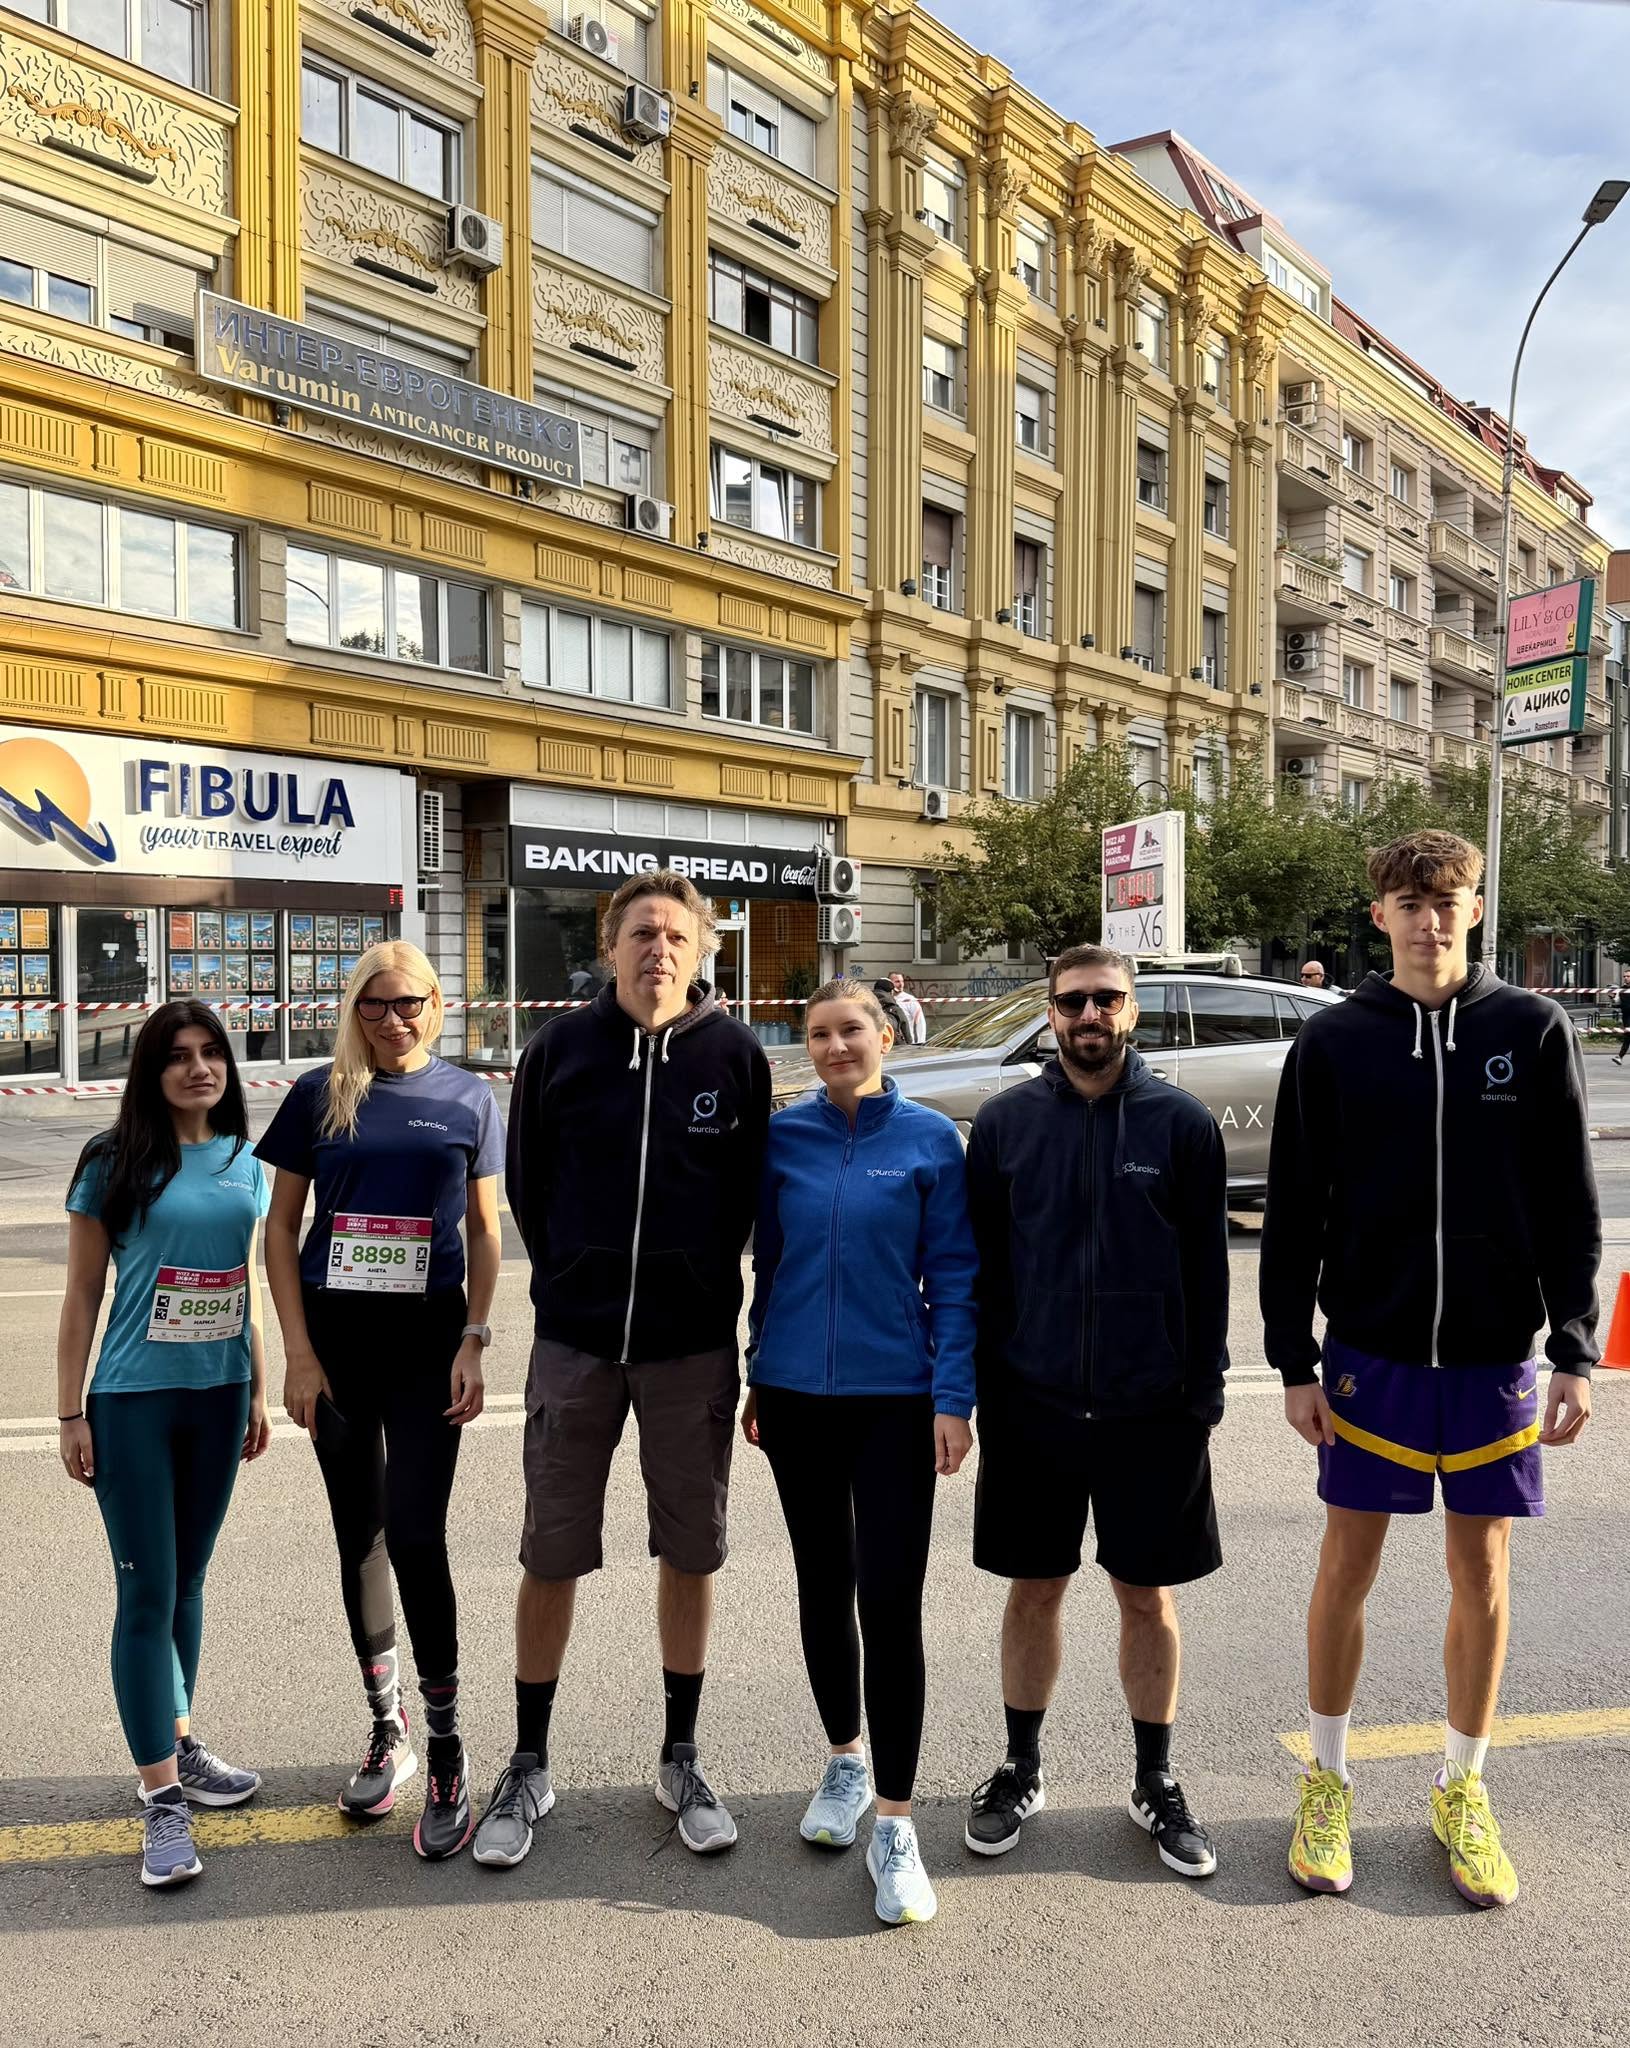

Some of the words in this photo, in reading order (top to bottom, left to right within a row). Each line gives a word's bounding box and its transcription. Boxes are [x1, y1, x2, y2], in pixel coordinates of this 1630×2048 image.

[213, 305, 574, 452] ИНТЕР-ЕВРОГЕНЕКС
[215, 344, 361, 413] Varumin
[369, 402, 490, 454] ANTICANCER
[495, 441, 574, 480] PRODUCT
[1514, 612, 1542, 632] LILY
[1544, 610, 1553, 624] &
[1556, 604, 1574, 621] CO
[1507, 675, 1534, 691] HOME
[1536, 665, 1571, 684] CENTER
[1524, 688, 1571, 713] АЏИКО
[138, 758, 355, 828] FIBULA
[143, 824, 202, 852] your
[206, 830, 276, 850] TRAVEL
[280, 831, 343, 860] expert
[525, 844, 658, 875] BAKING
[669, 855, 768, 883] BREAD
[1138, 910, 1163, 949] X6
[687, 1126, 720, 1134] sourcico
[1207, 1104, 1264, 1129] AX
[352, 1245, 407, 1265] 8898
[179, 1297, 232, 1316] 8894
